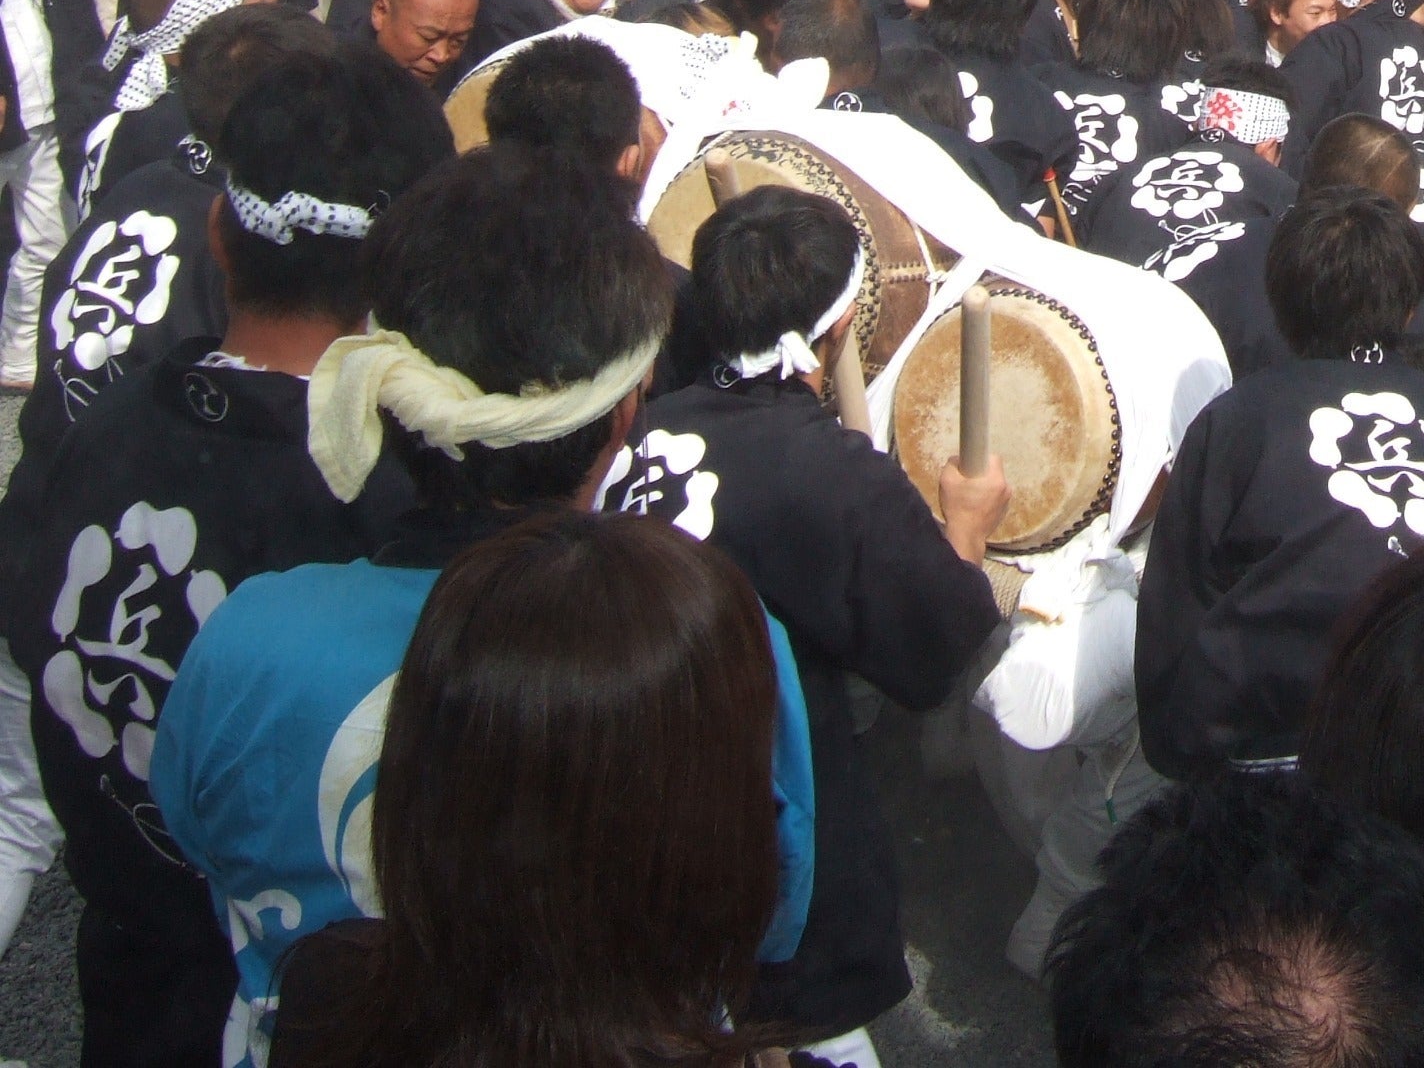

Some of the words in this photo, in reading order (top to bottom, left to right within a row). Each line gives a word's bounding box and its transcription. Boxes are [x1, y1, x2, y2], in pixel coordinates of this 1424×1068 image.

[1151, 161, 1212, 200] 兵
[72, 244, 134, 335] 兵
[76, 562, 177, 722] 兵
